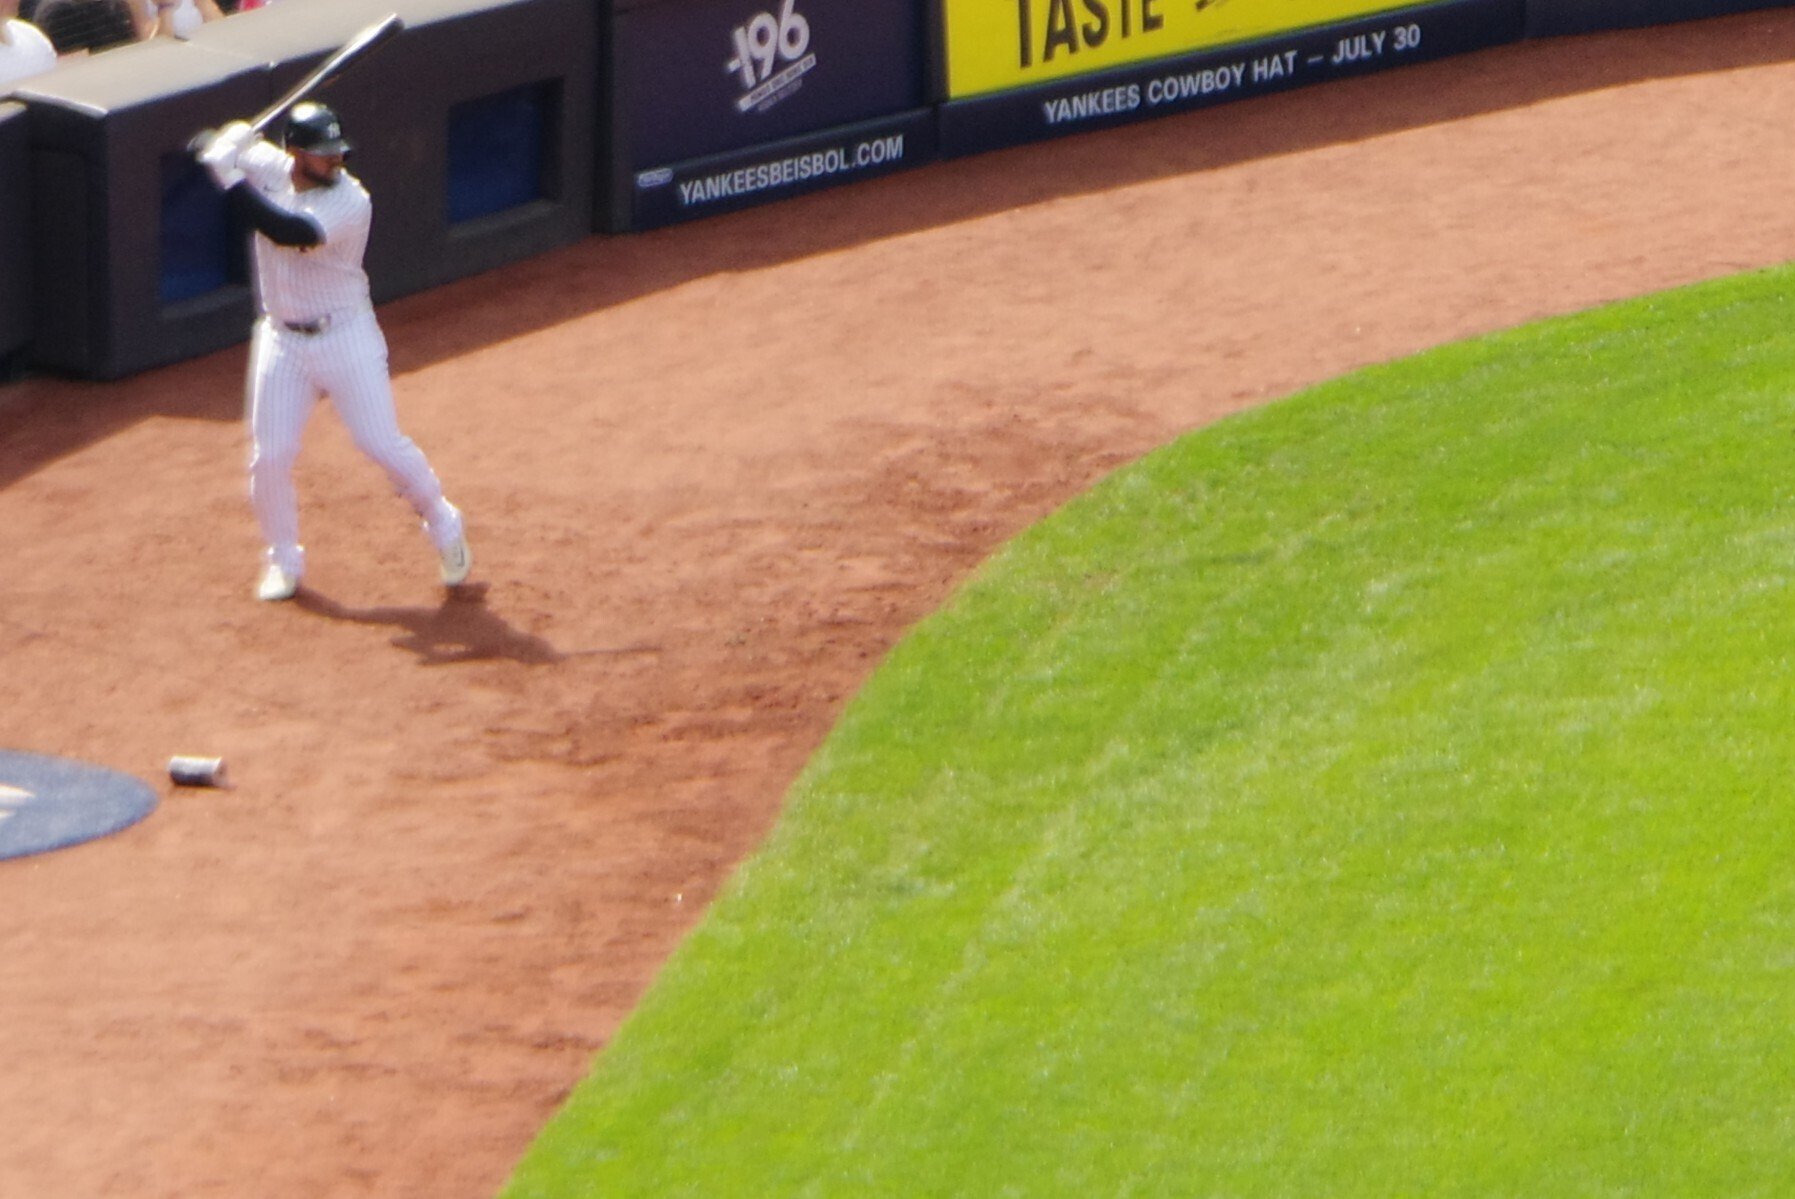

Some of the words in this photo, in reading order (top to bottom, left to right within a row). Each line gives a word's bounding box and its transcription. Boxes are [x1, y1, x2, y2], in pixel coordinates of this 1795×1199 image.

[1044, 83, 1141, 124] YANKEES
[1147, 62, 1243, 104] COWBOY
[1253, 49, 1297, 79] HAT
[1331, 32, 1386, 65] JULY
[1392, 22, 1421, 51] 30
[680, 134, 904, 205] YANKEESBEISBOL.COM
